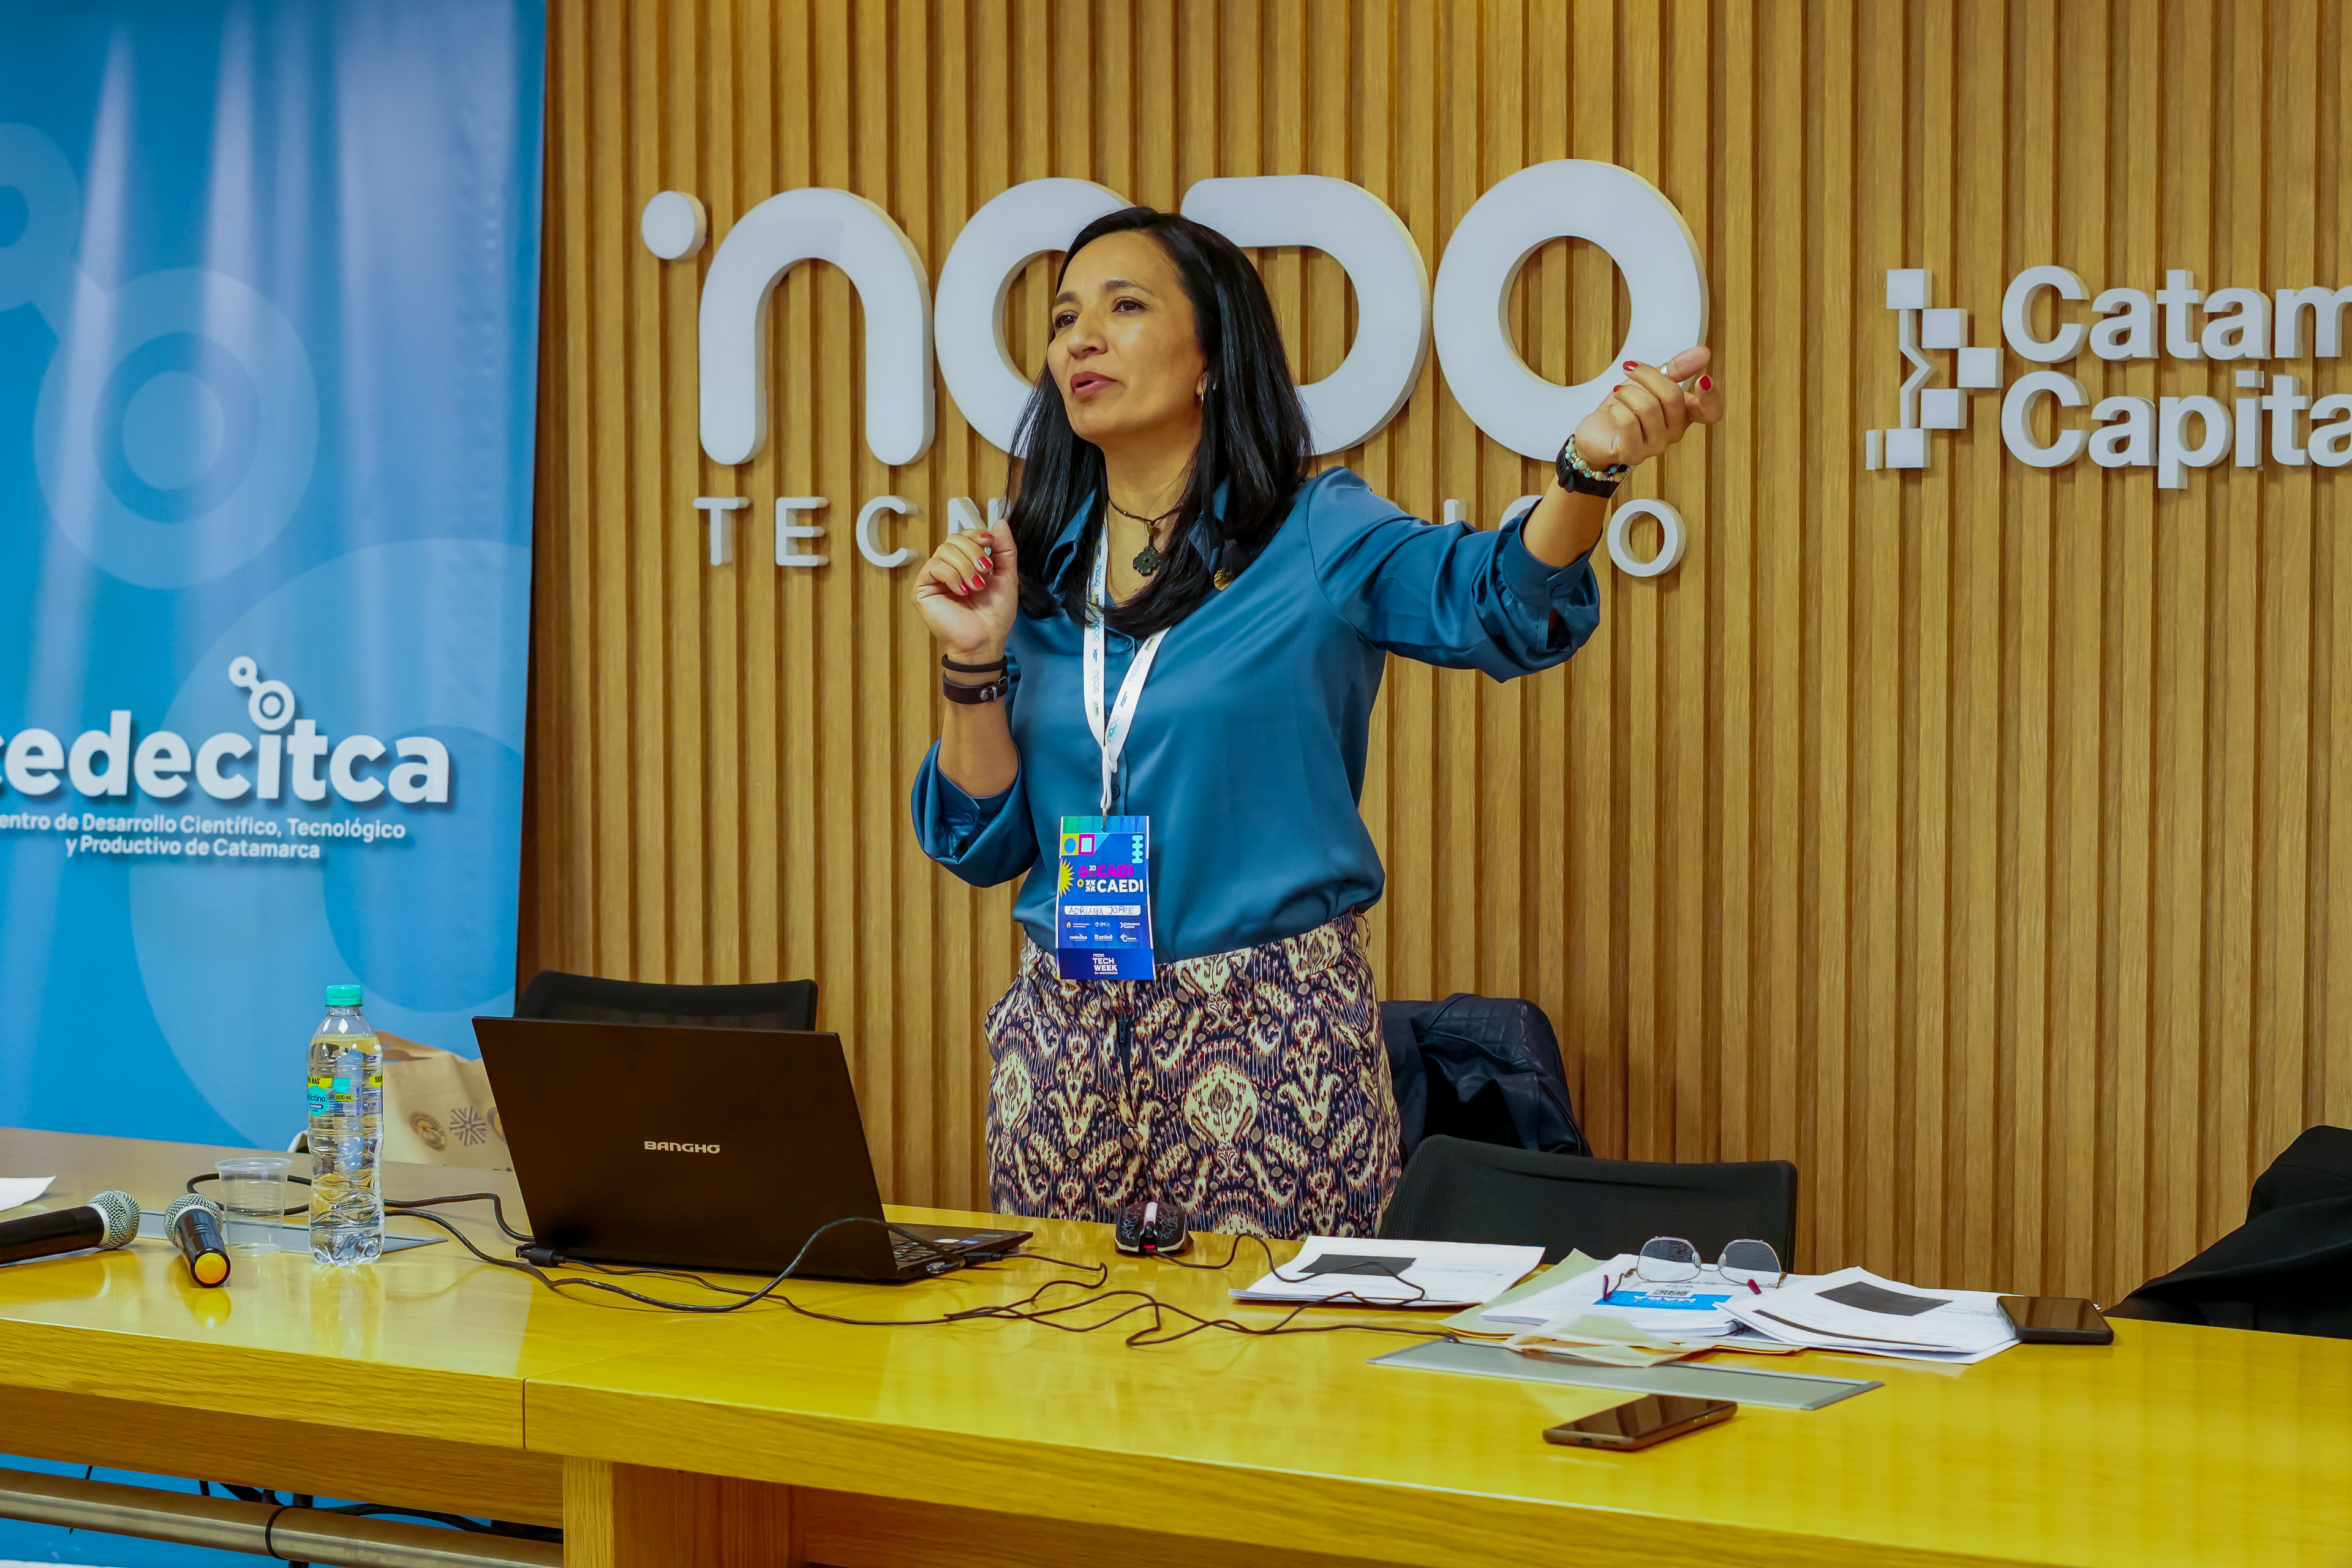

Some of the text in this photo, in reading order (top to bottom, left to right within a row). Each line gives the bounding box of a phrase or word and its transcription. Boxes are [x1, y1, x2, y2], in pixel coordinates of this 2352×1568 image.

[2001, 265, 2352, 364] Catam
[2000, 369, 2352, 489] Capita
[0, 710, 450, 804] edecitca
[54, 813, 79, 831] de
[82, 813, 178, 834] Desarrollo
[180, 815, 282, 838] Científico,
[287, 818, 406, 843] Tecnológico
[65, 835, 320, 859] y Productivo de Catamarca
[1097, 864, 1133, 878] CADI
[1097, 879, 1144, 893] CAEDI
[1069, 907, 1103, 915] ADRIANA
